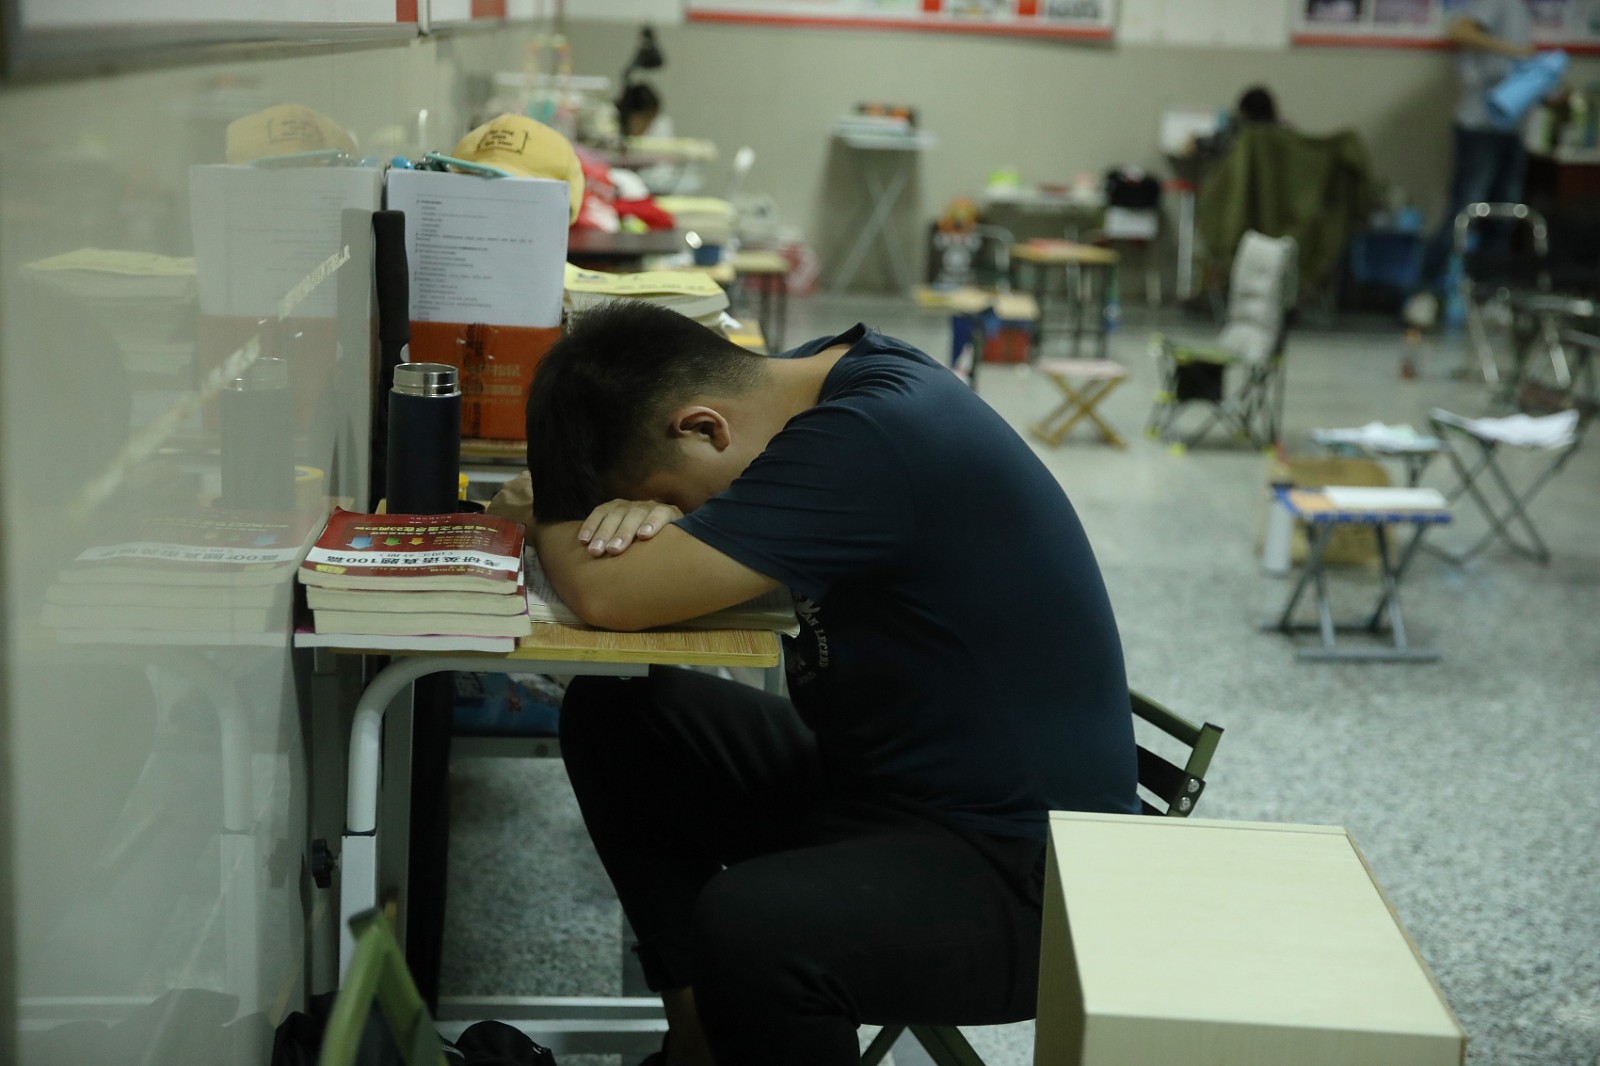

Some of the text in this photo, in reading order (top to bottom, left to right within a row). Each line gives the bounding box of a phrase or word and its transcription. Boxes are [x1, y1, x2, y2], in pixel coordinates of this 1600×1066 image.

[326, 555, 501, 567] 考研英语真题100篇
